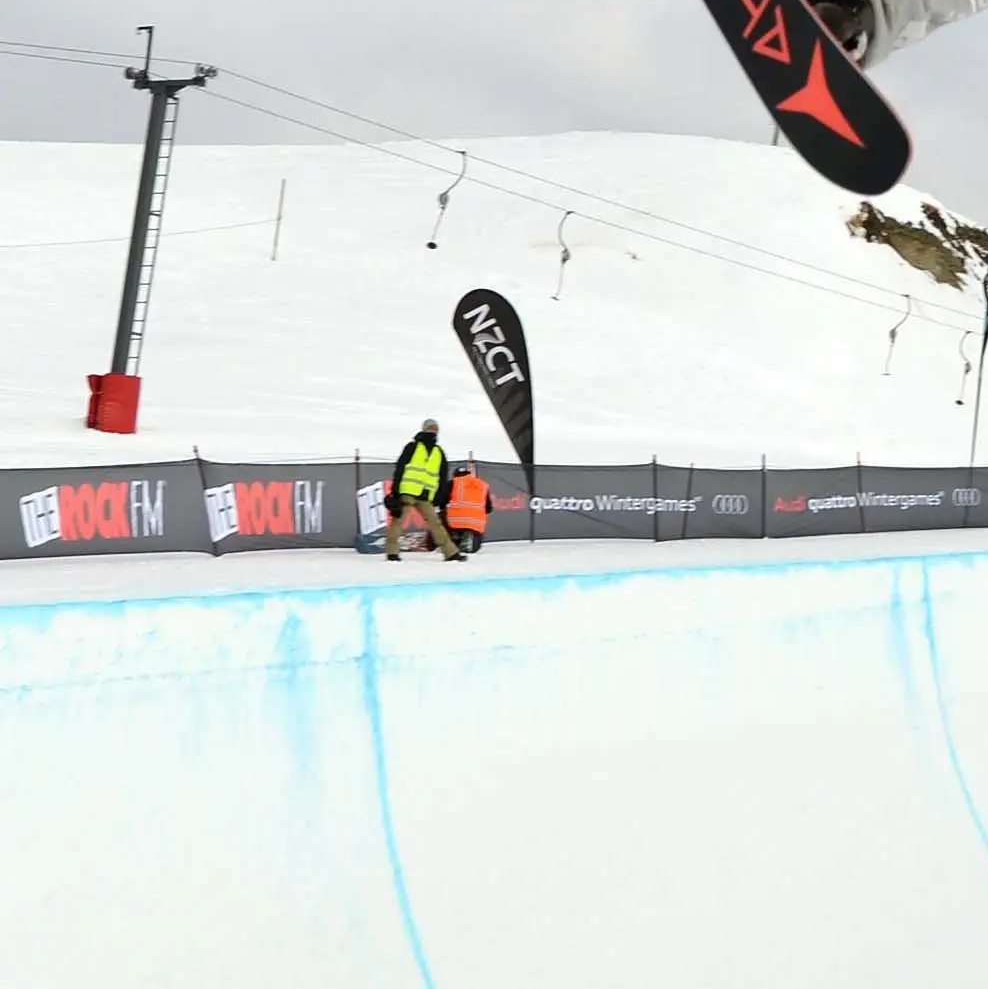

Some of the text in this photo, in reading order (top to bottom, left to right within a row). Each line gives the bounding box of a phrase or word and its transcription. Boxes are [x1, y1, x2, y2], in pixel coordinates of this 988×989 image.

[462, 303, 526, 387] NZCT
[60, 482, 131, 541] ROCK
[130, 480, 166, 537] FM
[235, 481, 294, 535] ROCK
[294, 480, 324, 534] FM
[529, 496, 595, 513] quattro
[807, 495, 857, 513] quattro
